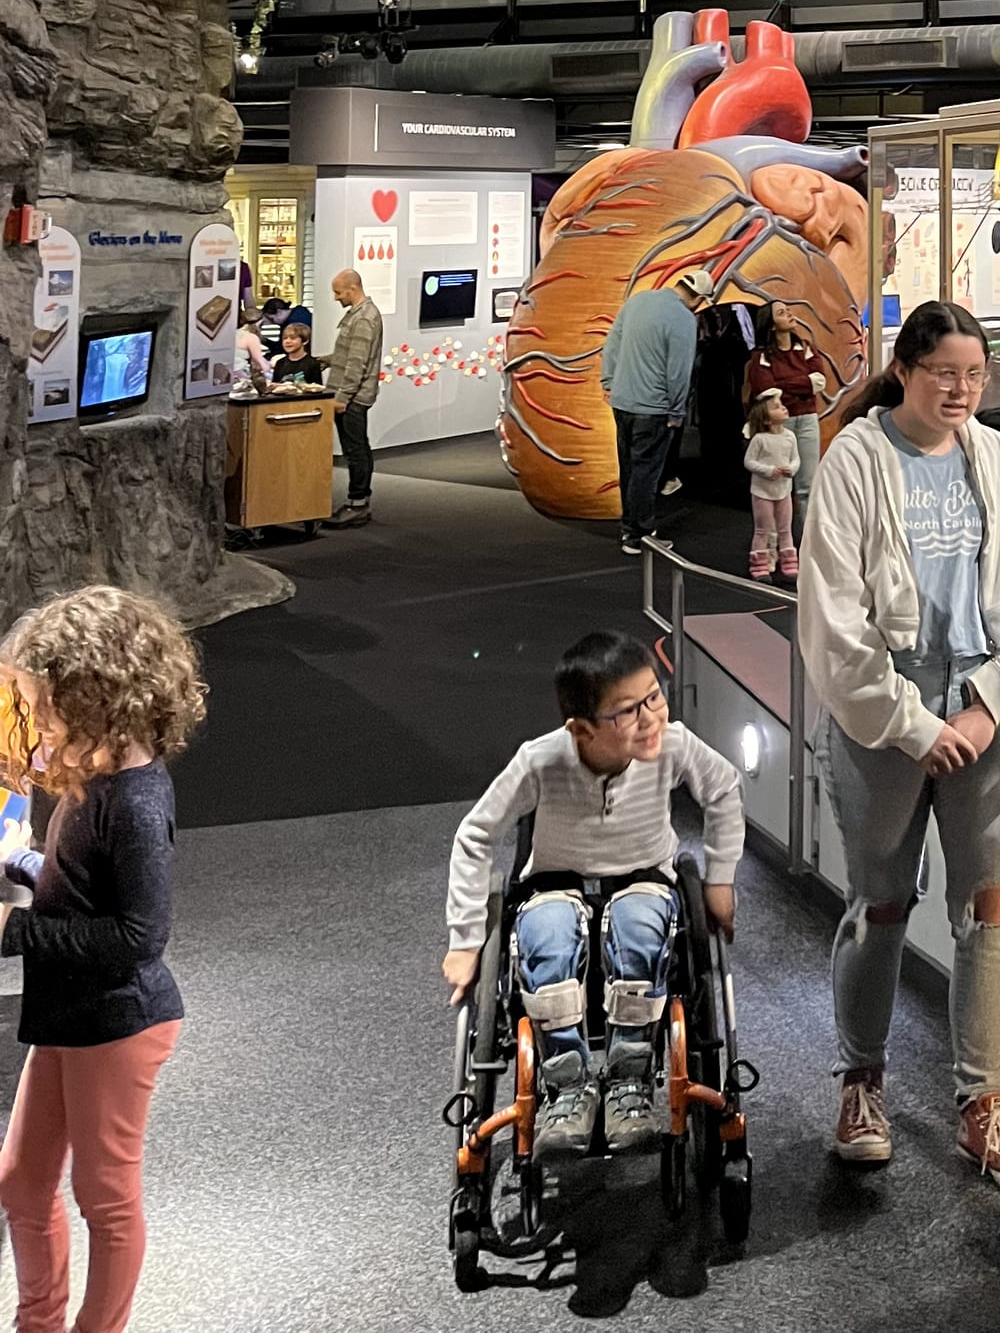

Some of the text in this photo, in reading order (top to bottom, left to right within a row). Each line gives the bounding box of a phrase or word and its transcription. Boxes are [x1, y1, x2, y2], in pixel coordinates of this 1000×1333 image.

[401, 122, 516, 138] YOUR CARDIOVASCULAR SYSTEM
[905, 485, 940, 508] uter
